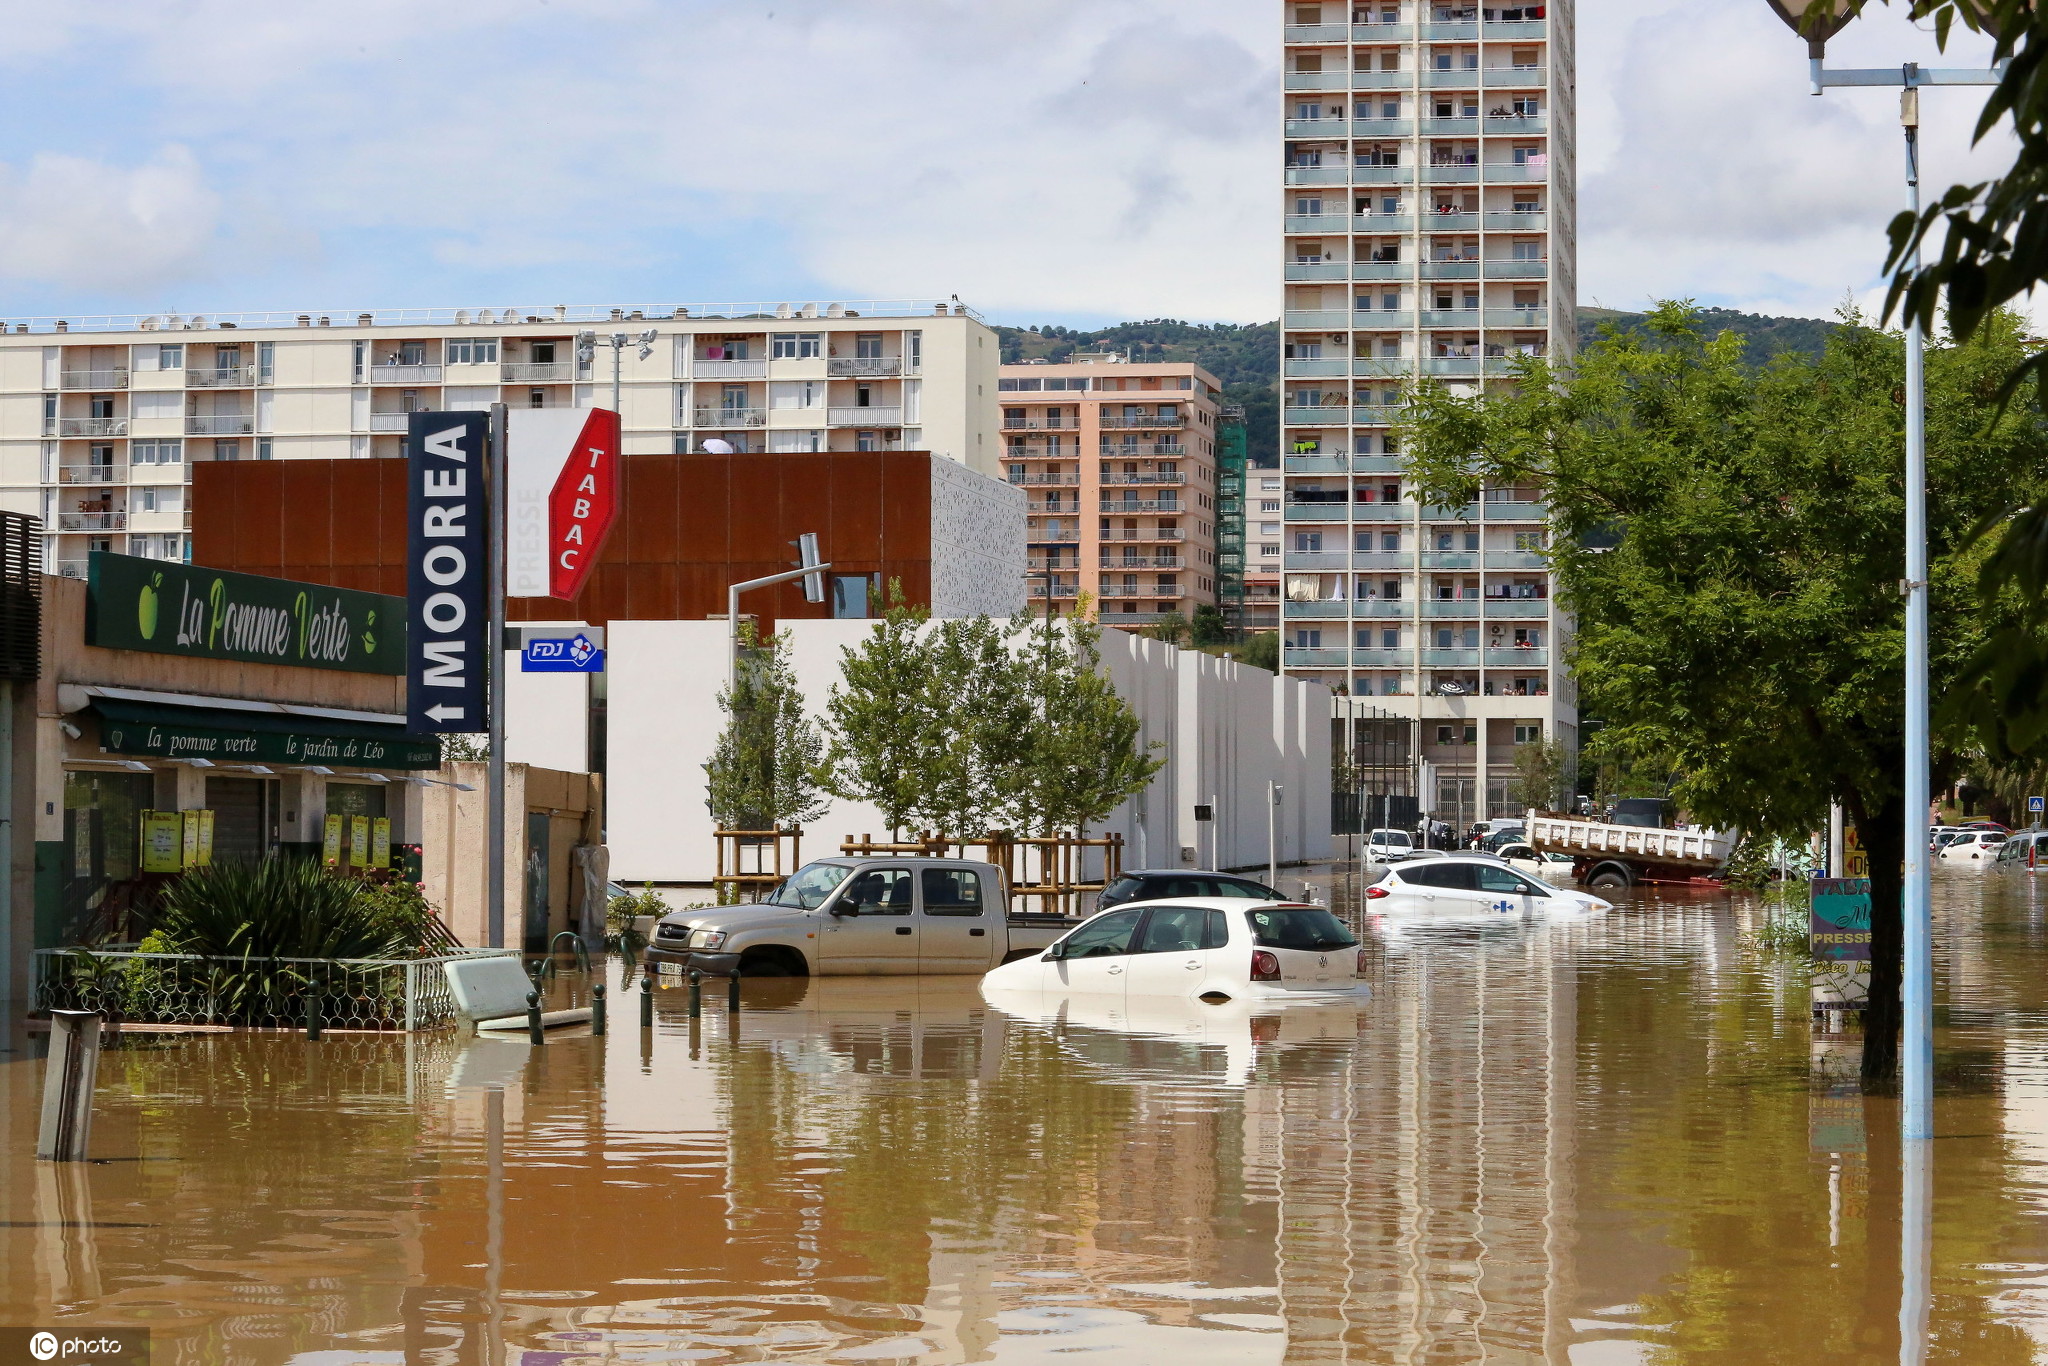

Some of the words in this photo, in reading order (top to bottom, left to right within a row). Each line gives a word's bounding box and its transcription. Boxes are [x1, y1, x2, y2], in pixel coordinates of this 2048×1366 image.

[560, 447, 605, 570] TABAC
[423, 424, 467, 688] MOOREA
[517, 488, 541, 590] PRESSE
[176, 579, 204, 649] La
[209, 577, 291, 656] Pomme
[295, 589, 351, 662] Verte
[532, 642, 564, 657] FDJ
[147, 726, 162, 748] la
[168, 735, 218, 756] pomme
[224, 736, 257, 752] verte
[286, 734, 297, 755] le
[300, 737, 339, 762] jardin
[343, 738, 358, 758] de
[363, 741, 384, 759] Léo
[1813, 932, 1872, 944] PRESSE
